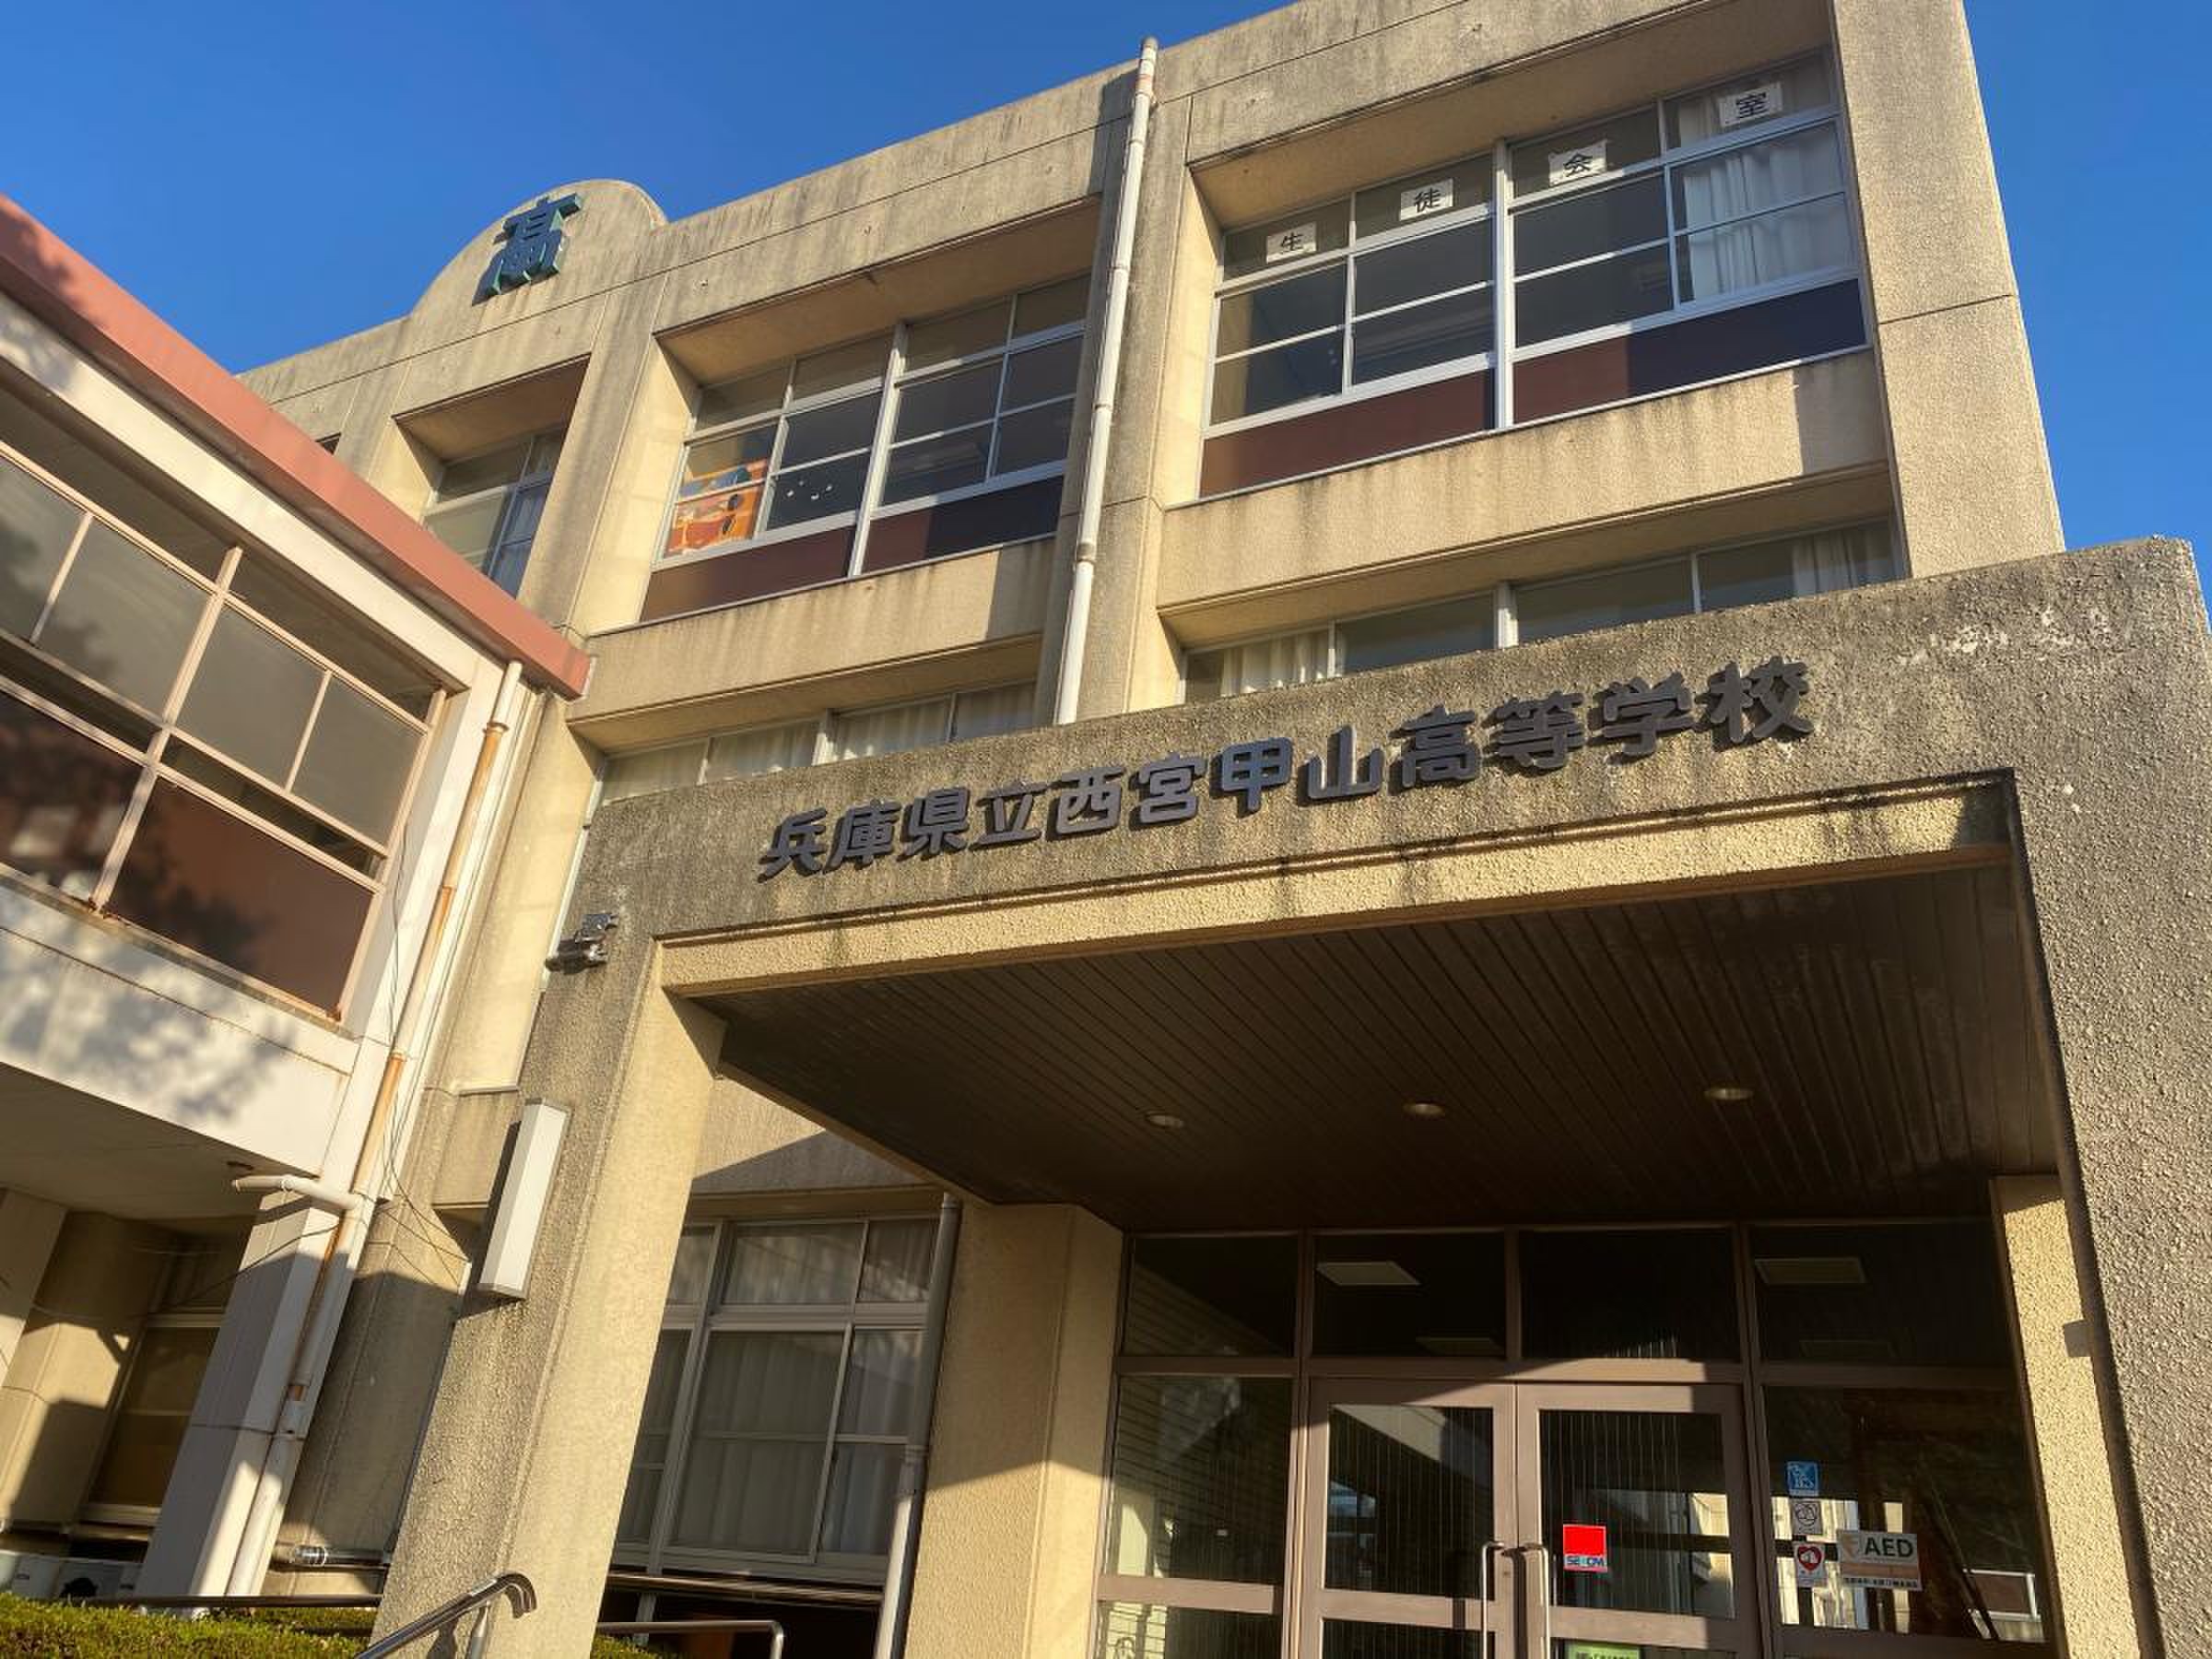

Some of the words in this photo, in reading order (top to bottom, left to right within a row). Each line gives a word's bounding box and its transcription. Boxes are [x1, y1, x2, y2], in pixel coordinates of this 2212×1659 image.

[1281, 232, 1304, 252] 生
[1414, 188, 1441, 212] 徒
[1564, 153, 1593, 175] 会
[1736, 91, 1767, 119] 室
[758, 655, 1814, 882] 兵庫県立西宮甲山高等学校
[1865, 1536, 1913, 1558] AED
